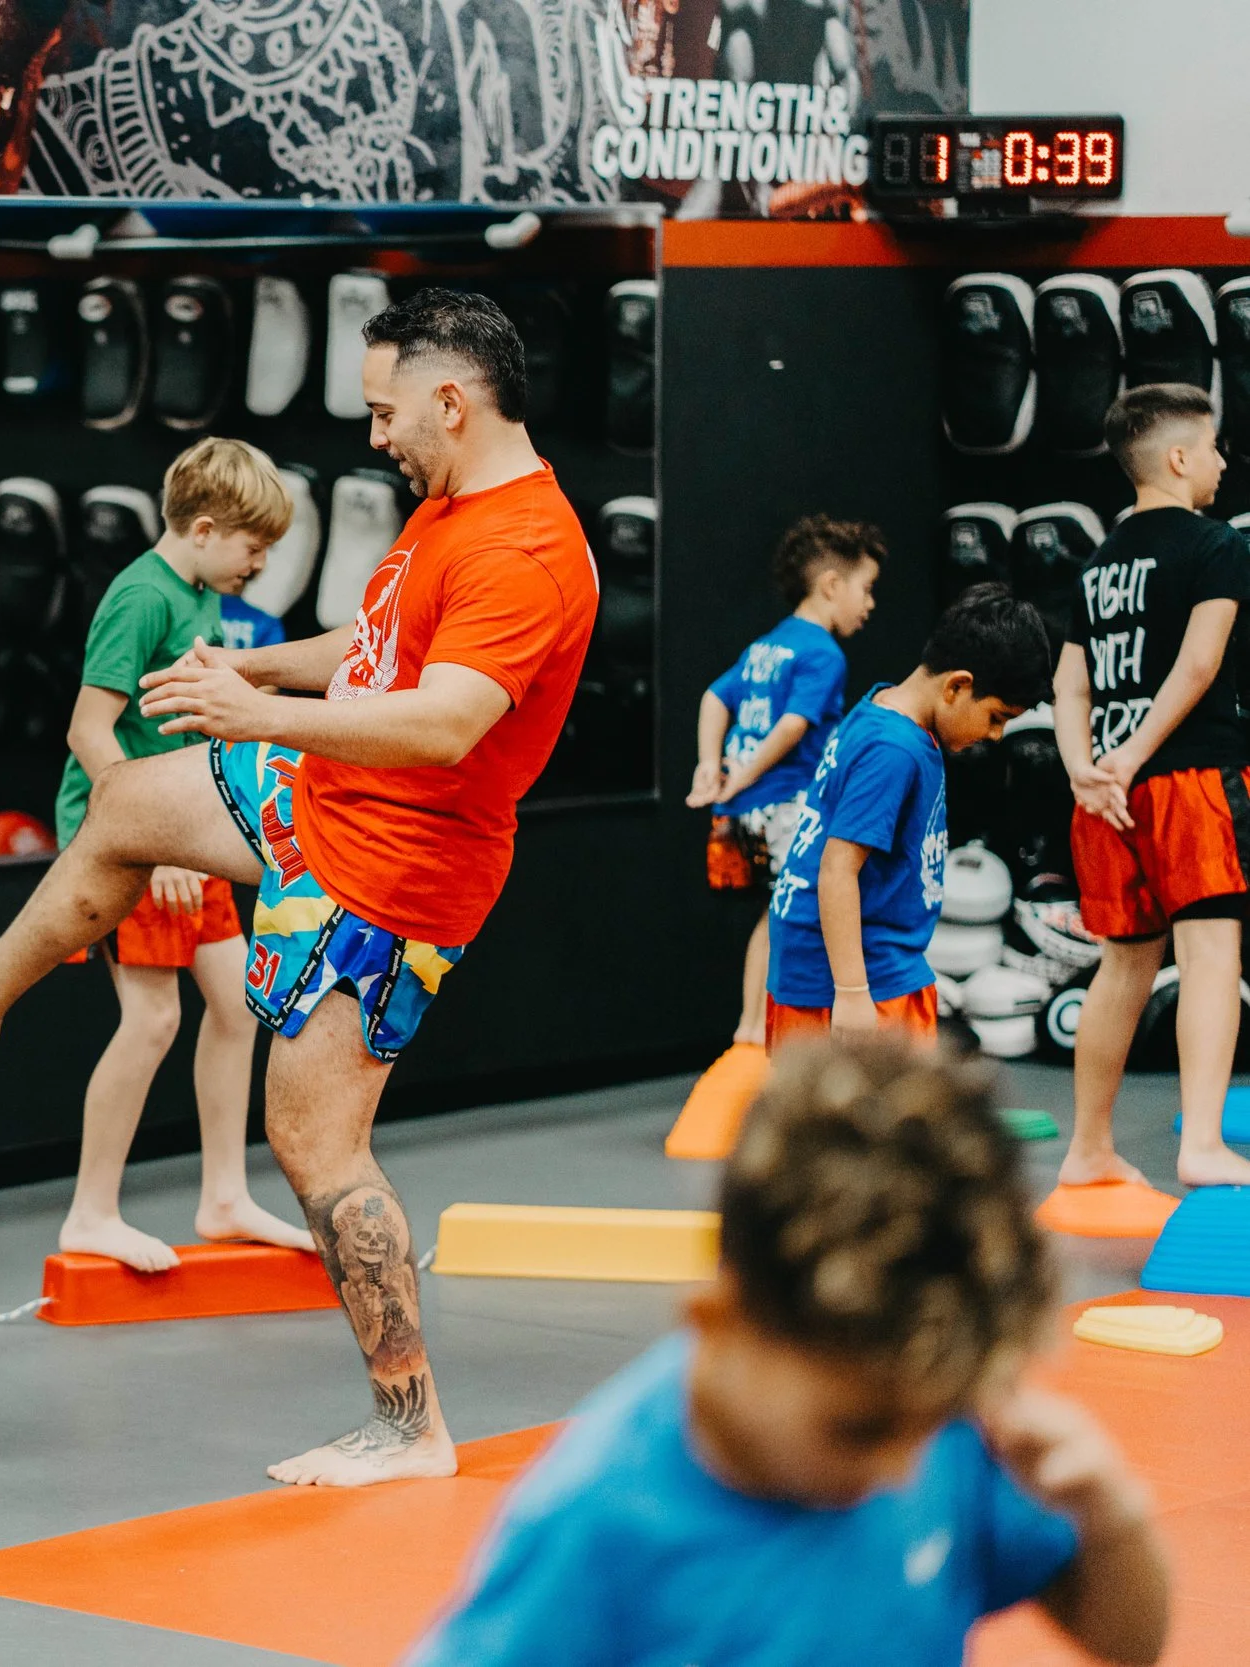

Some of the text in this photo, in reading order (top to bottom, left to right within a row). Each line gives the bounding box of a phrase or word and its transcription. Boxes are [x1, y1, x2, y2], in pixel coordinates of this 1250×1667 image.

[592, 125, 869, 186] CONDITIONING
[1004, 132, 1114, 185] 0:39
[1082, 557, 1157, 626] FIGHT
[247, 940, 282, 1001] 31
